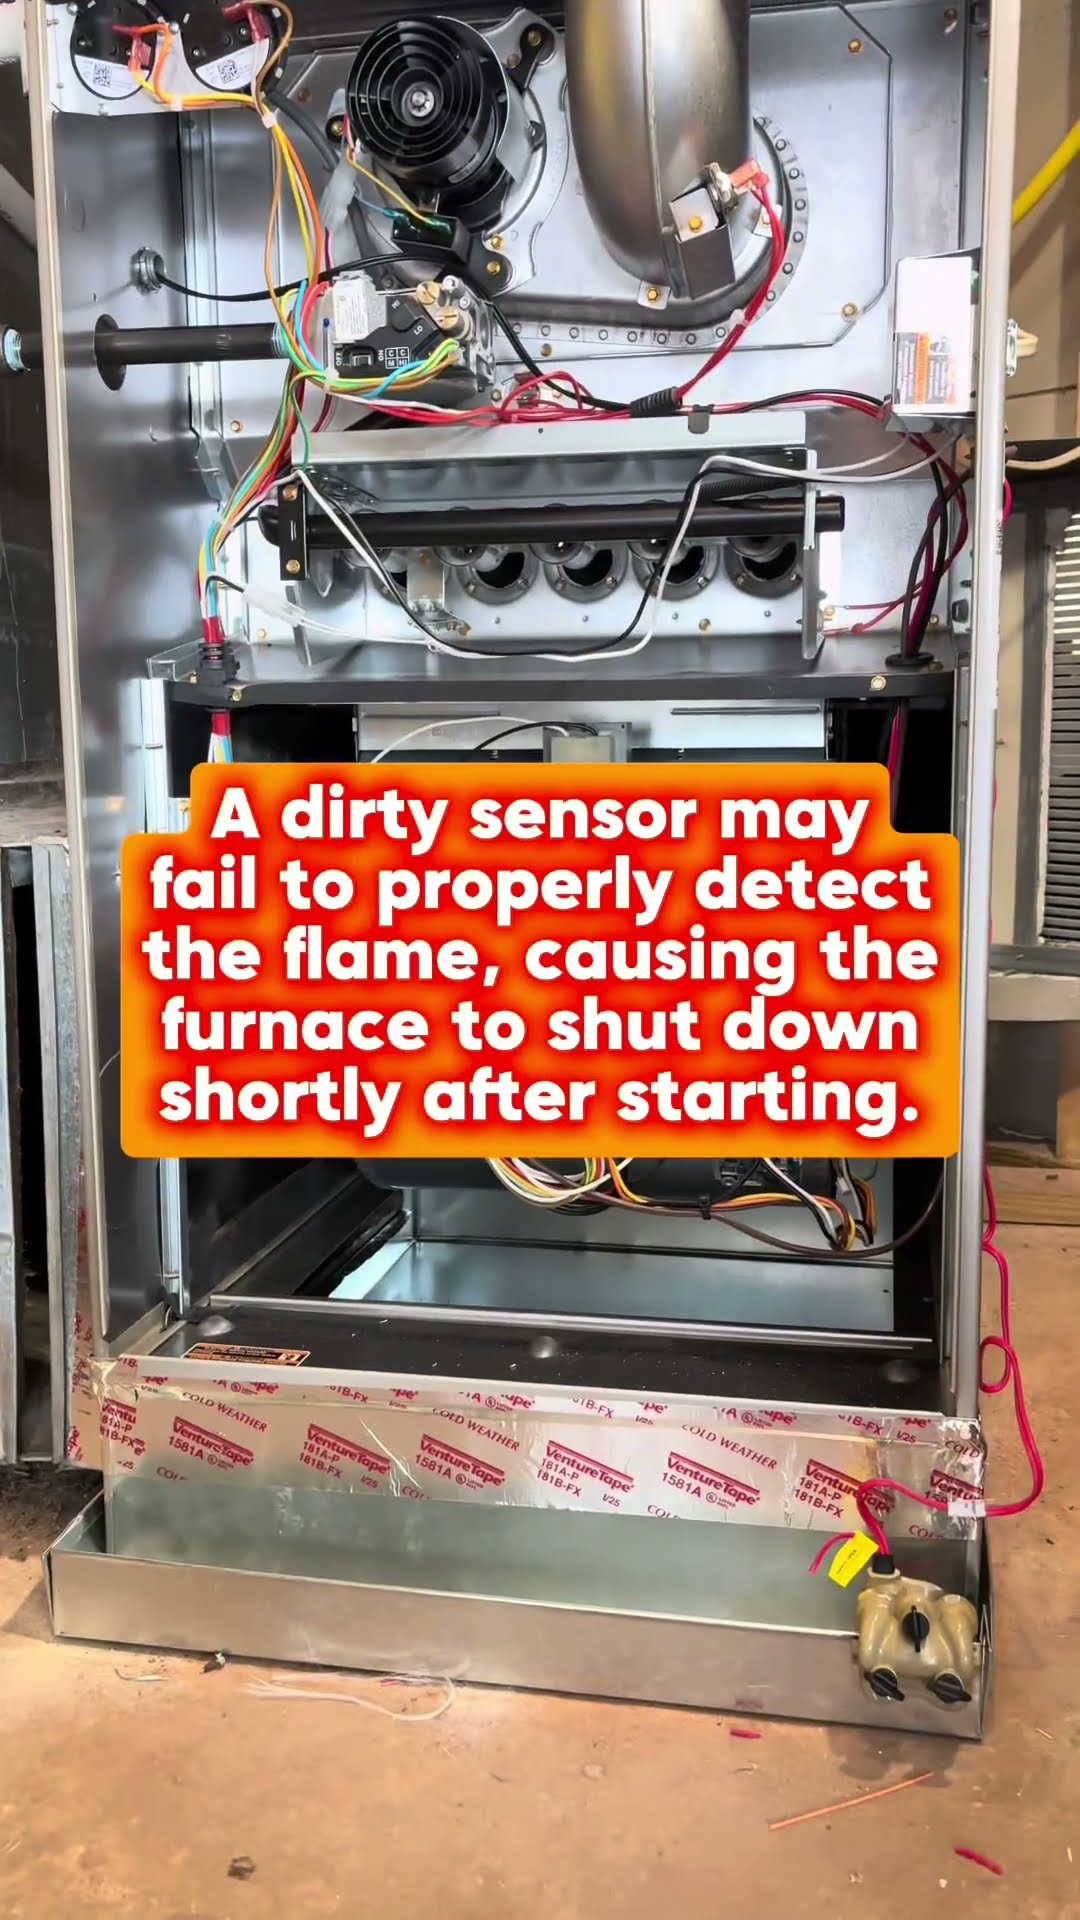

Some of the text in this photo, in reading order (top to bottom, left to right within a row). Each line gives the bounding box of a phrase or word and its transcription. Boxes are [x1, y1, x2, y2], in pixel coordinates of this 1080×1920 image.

[413, 325, 424, 335] LO
[182, 1391, 268, 1432] COLD WEATHER
[432, 1407, 520, 1451] COLD WEATHER
[168, 1435, 204, 1461] 1581A
[303, 1440, 341, 1463] 181A-P
[681, 1424, 778, 1470] COLD WEATHER
[299, 1452, 343, 1479] 181B-FX
[415, 1454, 451, 1480] 1581A
[541, 1457, 580, 1480] 181A-P
[537, 1469, 583, 1498] 181B-FX
[662, 1472, 701, 1498] 1581A
[800, 1476, 842, 1501] 181A-P
[794, 1488, 844, 1518] 181B-FX
